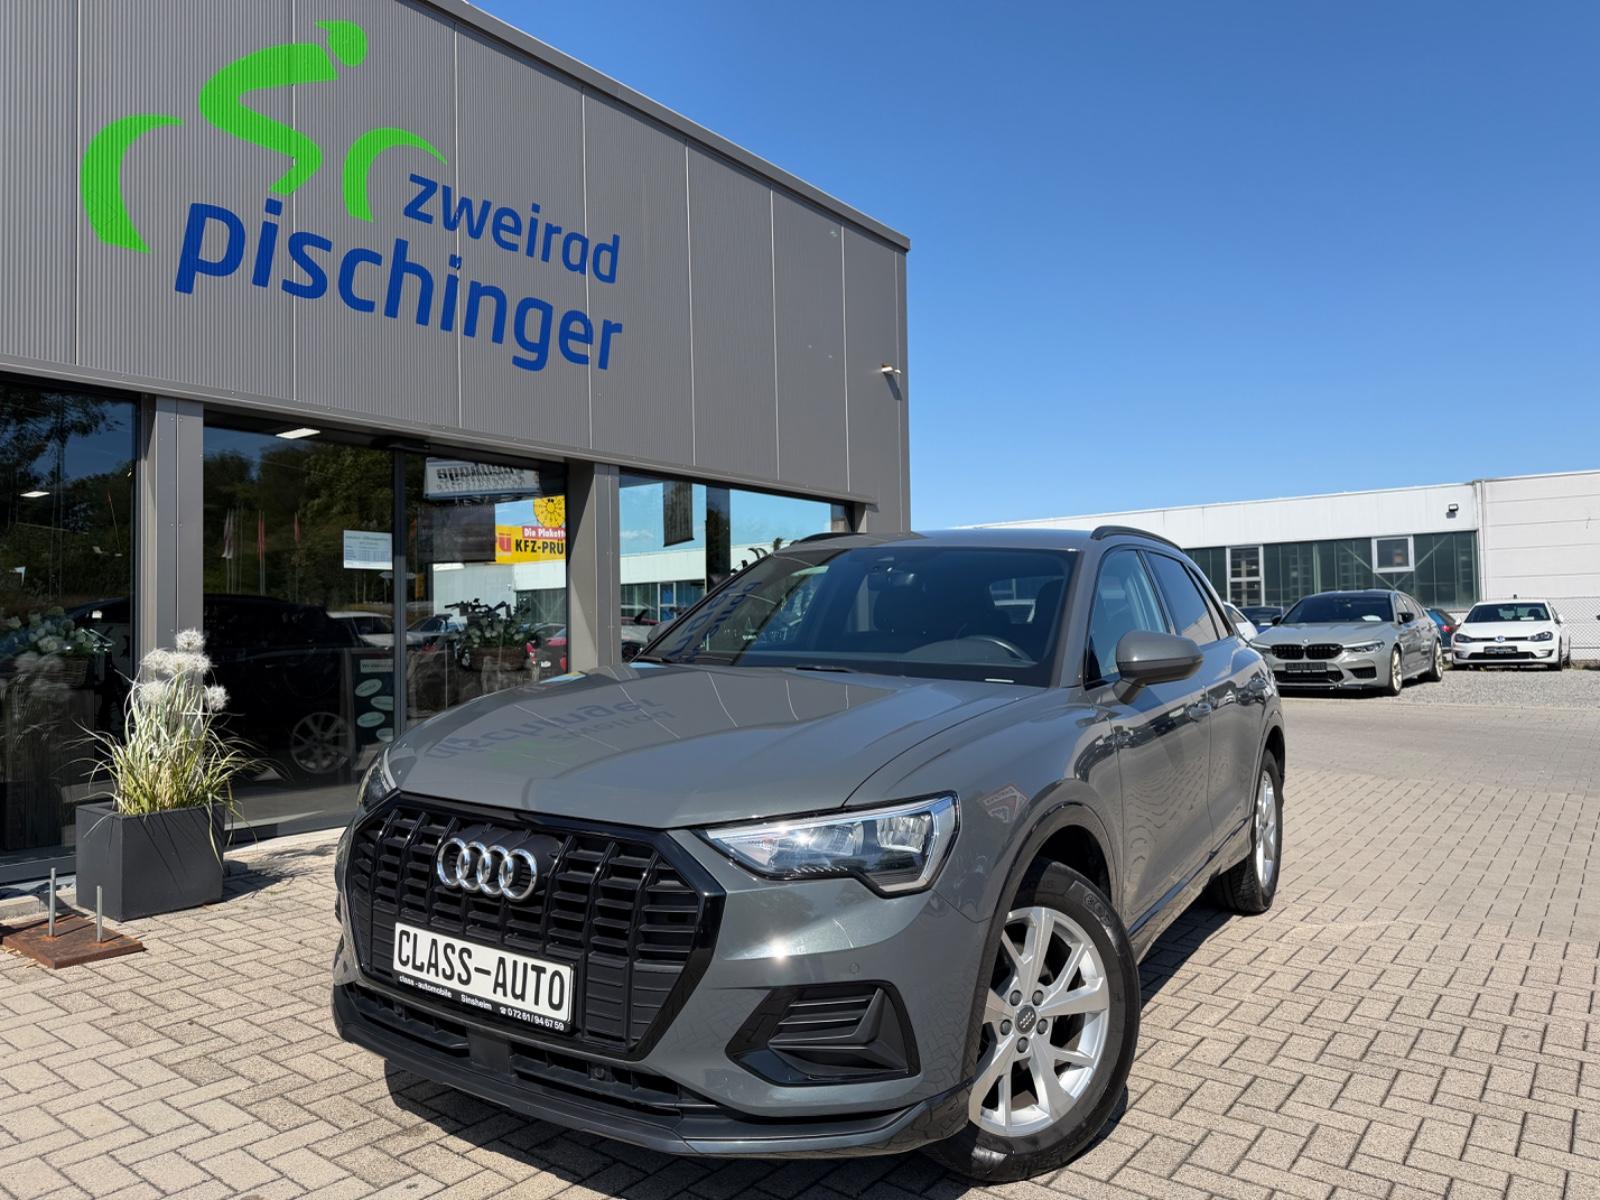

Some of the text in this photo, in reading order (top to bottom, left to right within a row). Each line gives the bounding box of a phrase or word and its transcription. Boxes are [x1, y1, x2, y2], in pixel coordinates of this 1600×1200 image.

[402, 173, 621, 284] zweirad
[174, 198, 623, 372] pischinger
[523, 527, 536, 537] Die
[397, 929, 565, 1011] CLASS-AUTO
[461, 994, 493, 1011] Sinsheim
